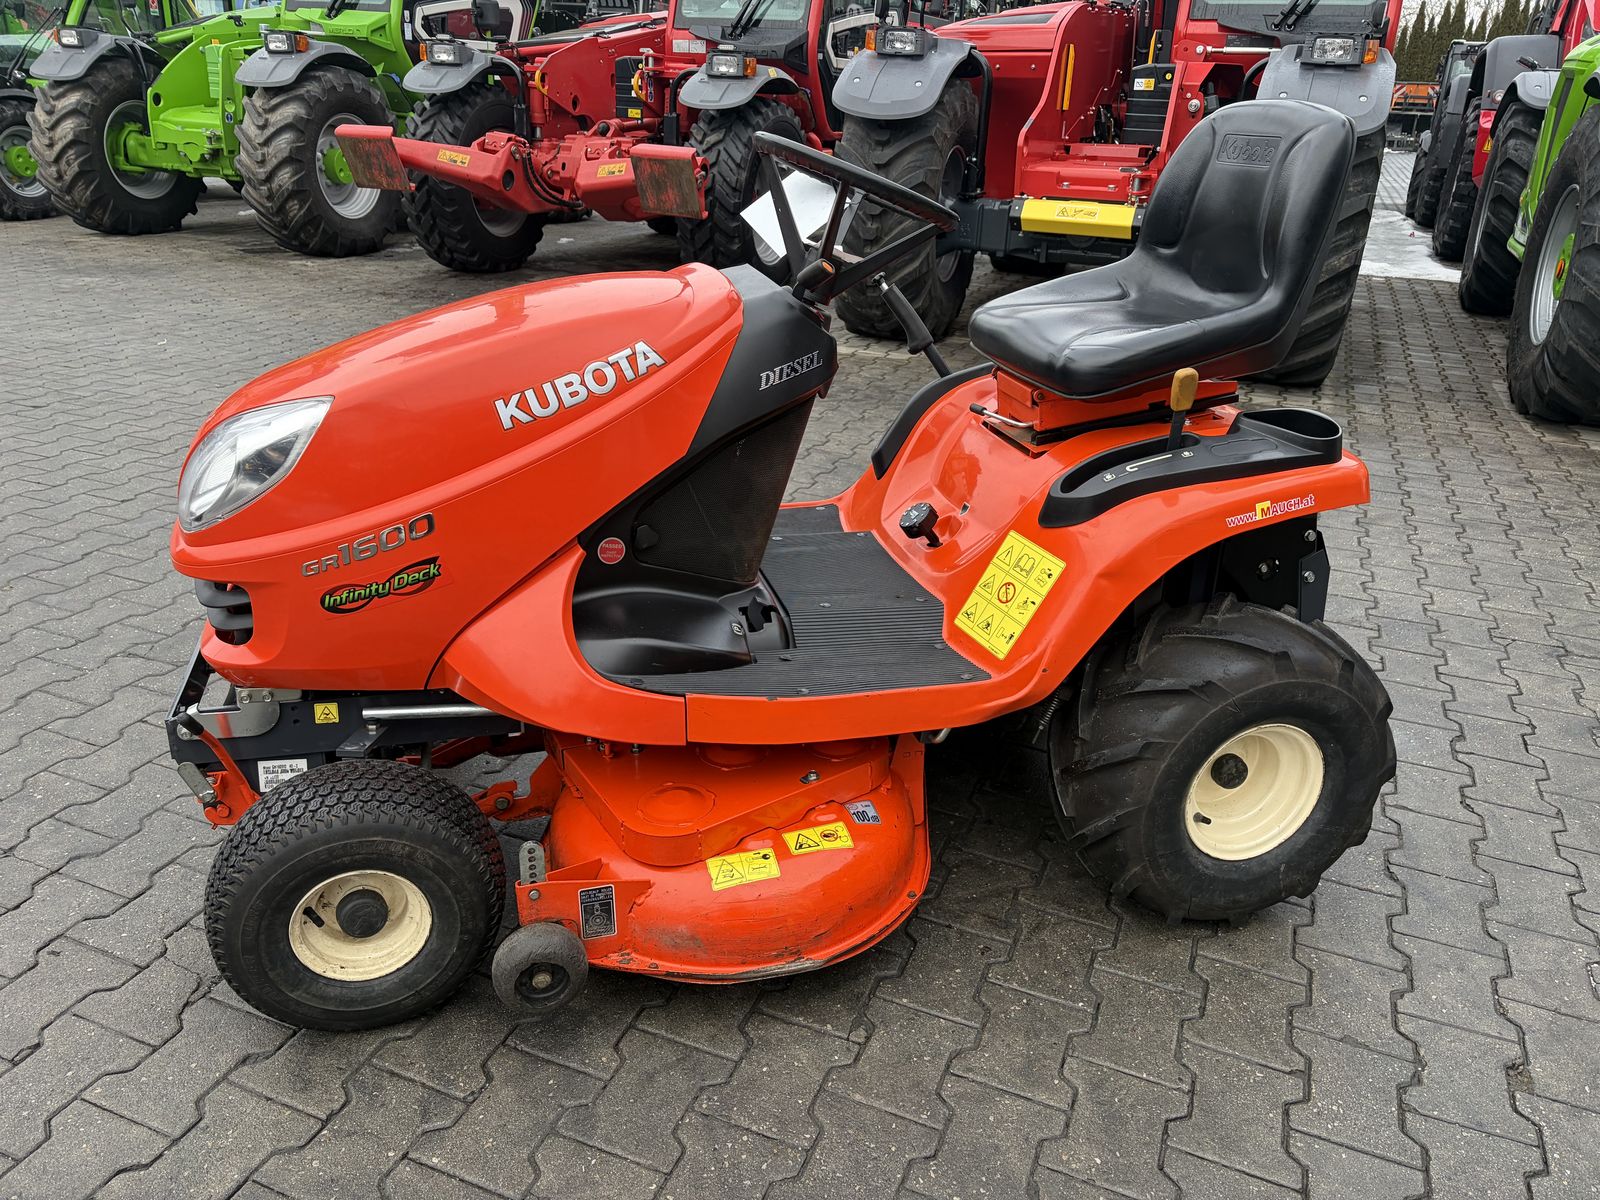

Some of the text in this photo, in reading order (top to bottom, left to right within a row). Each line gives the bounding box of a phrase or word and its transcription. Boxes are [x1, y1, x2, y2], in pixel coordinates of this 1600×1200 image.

[494, 340, 667, 431] KUBOTA
[759, 350, 823, 390] DIESEL
[1226, 494, 1315, 527] www.MAUCH.at
[301, 511, 435, 577] GR1600
[322, 563, 441, 608] Infinity Deck
[852, 810, 880, 823] 100 dB
